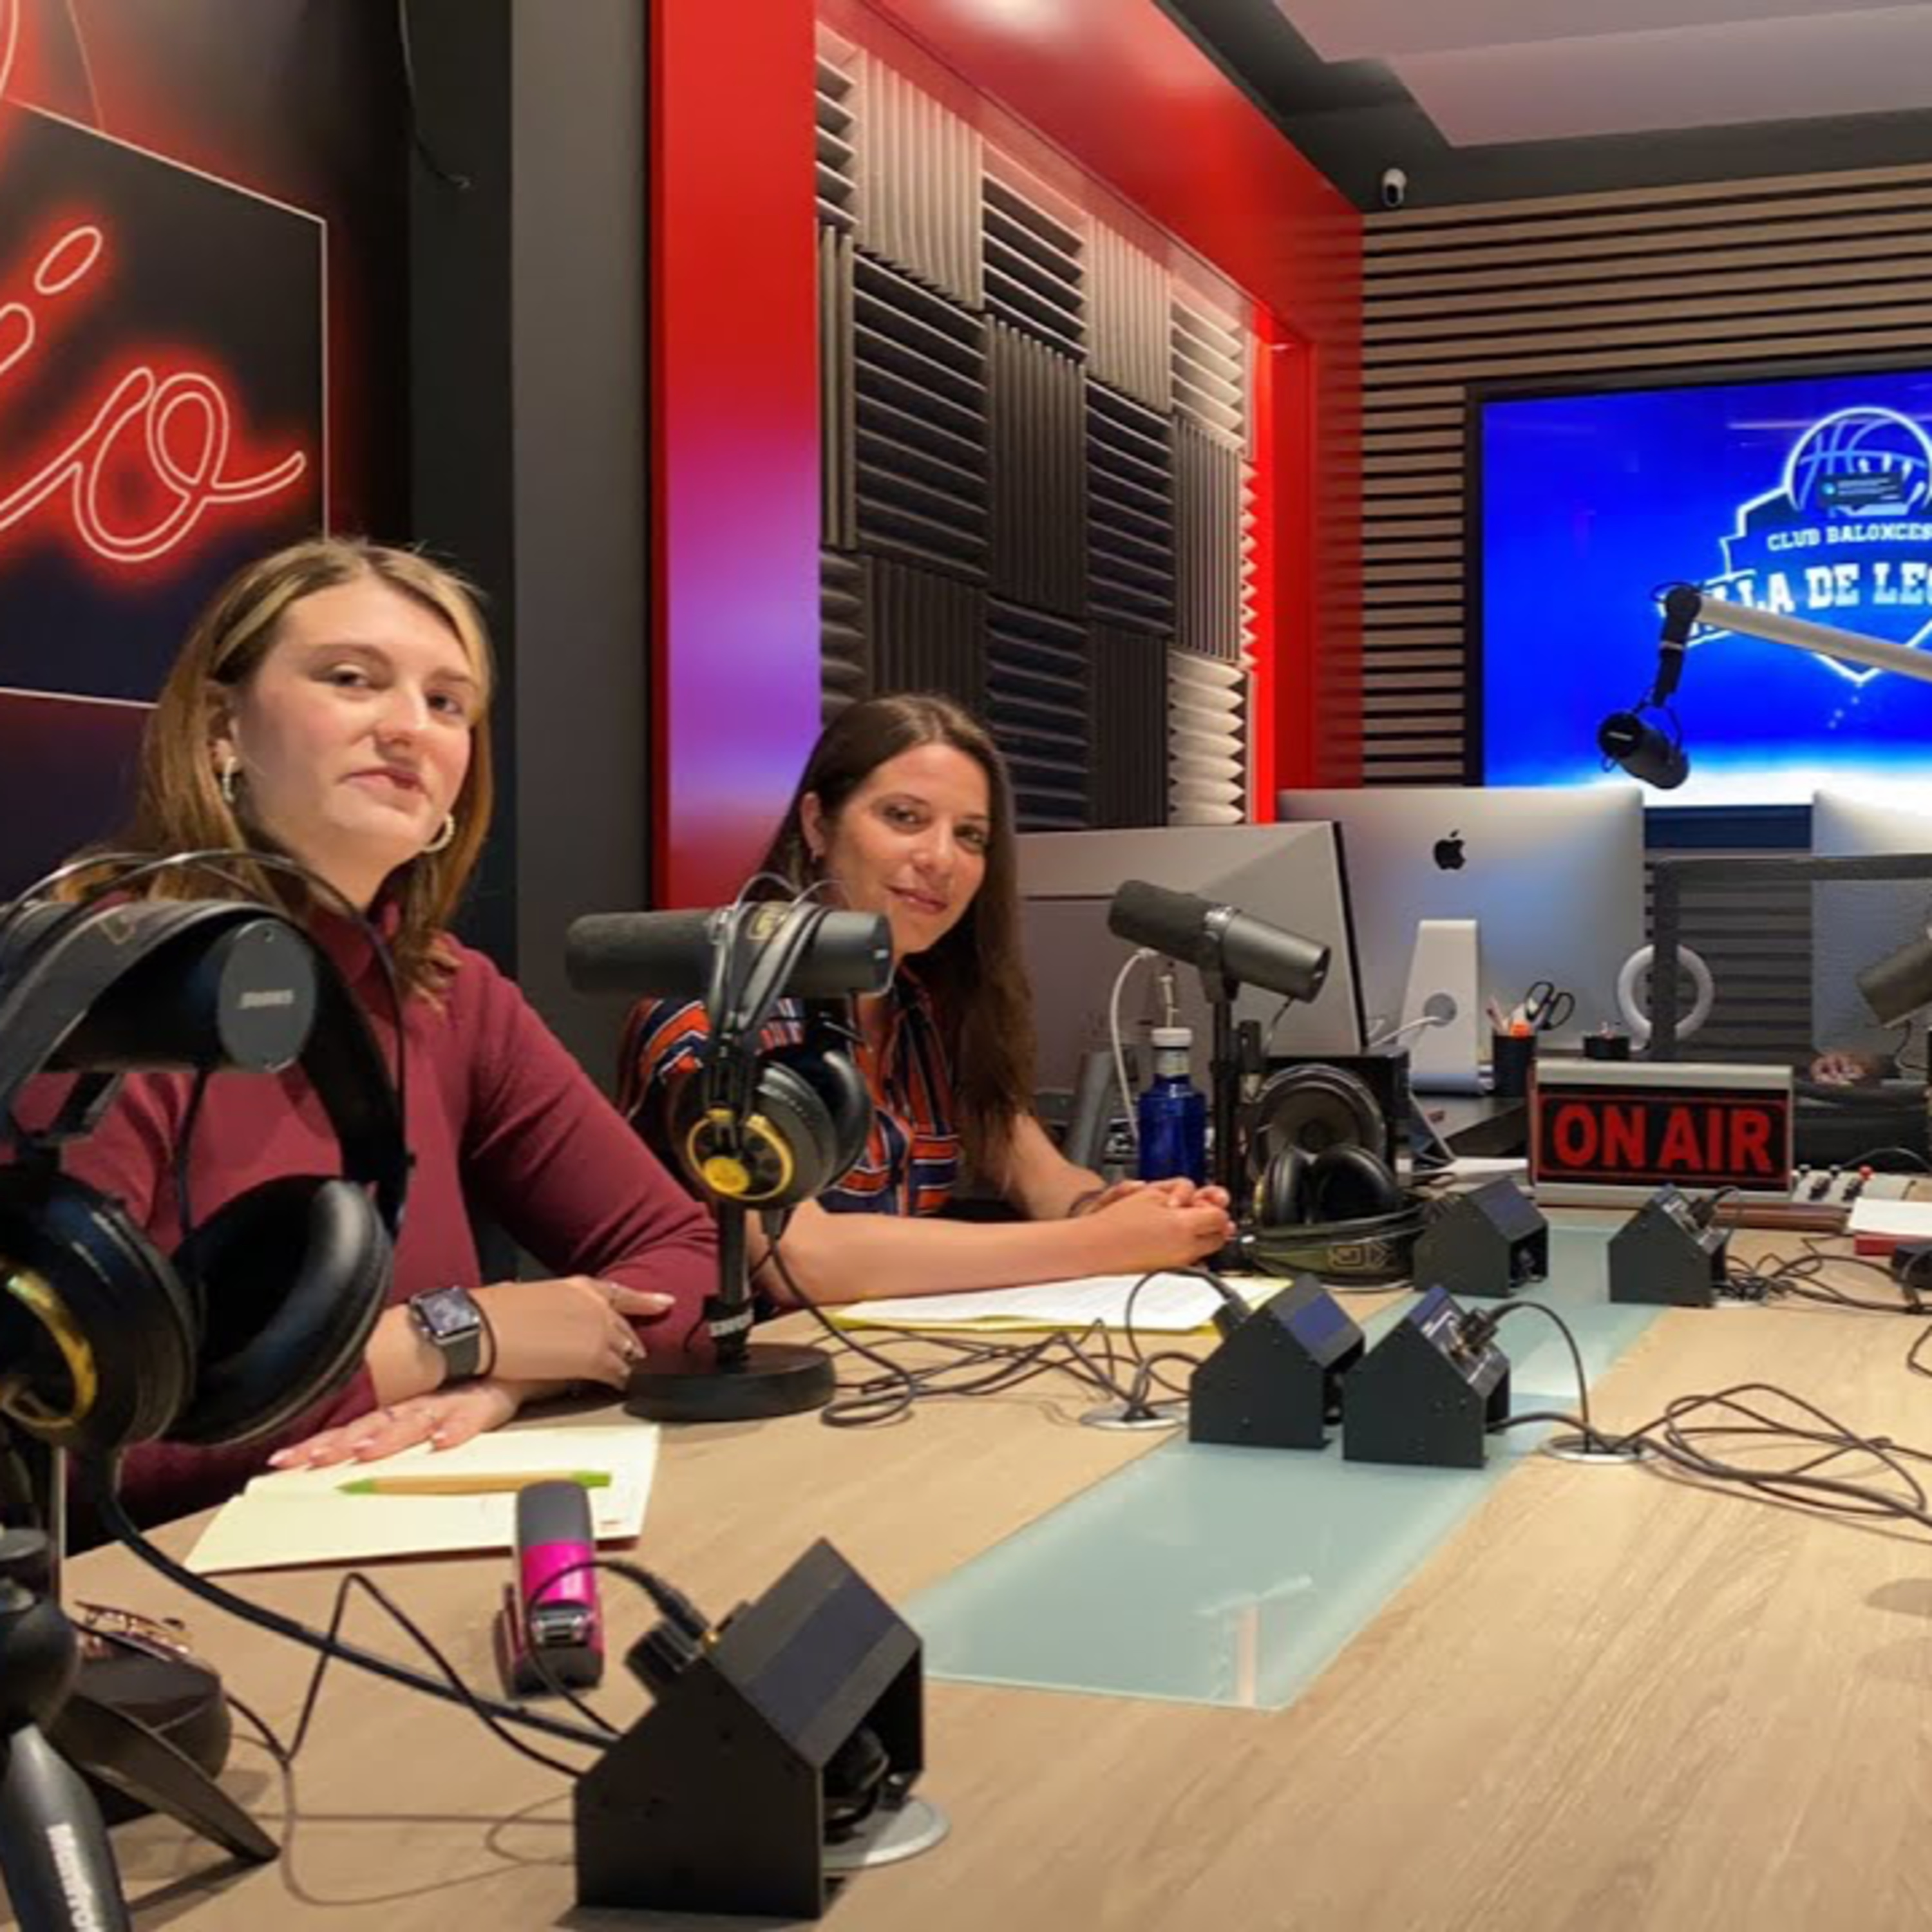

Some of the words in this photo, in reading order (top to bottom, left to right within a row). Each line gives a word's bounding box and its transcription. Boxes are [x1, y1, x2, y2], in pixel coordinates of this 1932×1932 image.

[1767, 527, 1821, 551] CLUB
[1805, 562, 1861, 610] DE
[1873, 561, 1932, 605] LE
[1553, 1103, 1647, 1168] ON
[1658, 1106, 1773, 1173] AIR
